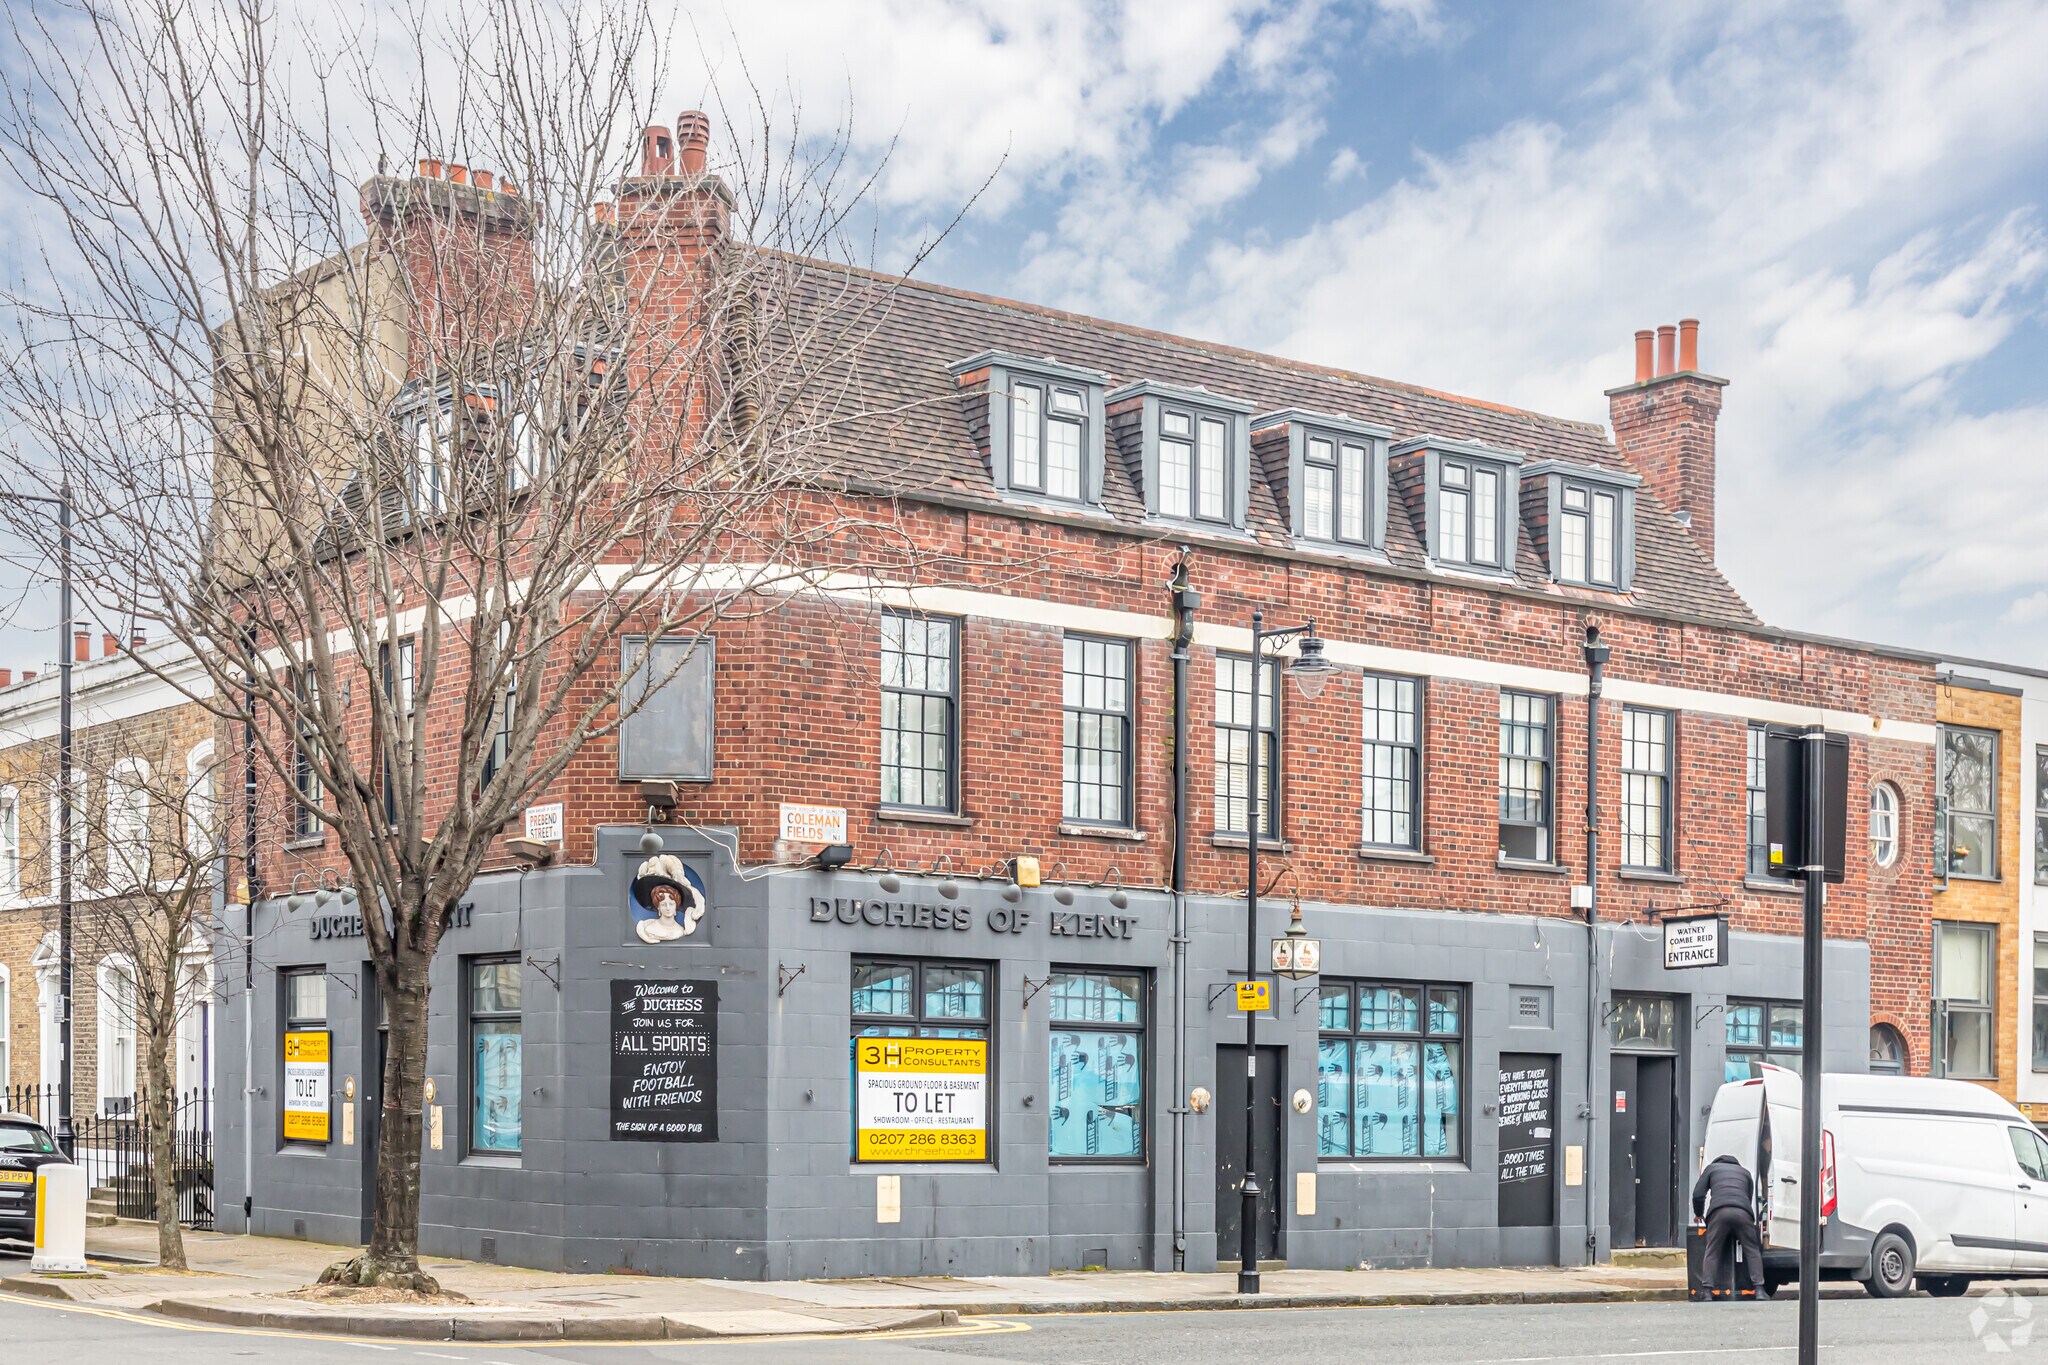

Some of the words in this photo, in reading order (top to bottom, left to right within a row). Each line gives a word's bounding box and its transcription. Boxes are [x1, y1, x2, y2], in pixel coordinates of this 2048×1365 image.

[530, 813, 558, 827] PREBEND
[787, 812, 841, 828] COLEMAN
[530, 826, 553, 839] STREET
[786, 826, 824, 840] FIELDS
[810, 896, 973, 931] DUCHESS
[988, 907, 1032, 935] OF
[1050, 911, 1141, 940] KENT
[309, 914, 364, 940] DUCHE
[1677, 926, 1706, 936] WATNEY
[1670, 936, 1693, 946] COMBE
[1697, 934, 1714, 943] REID
[1668, 948, 1714, 963] ENTRANCE
[634, 984, 679, 997] Welcome
[681, 984, 694, 994] to
[624, 1000, 636, 1010] THE
[644, 998, 702, 1012] DUCHESS
[632, 1018, 654, 1027] JOIN
[657, 1018, 672, 1028] US
[675, 1018, 703, 1028] FOR...
[620, 1036, 648, 1052] ALL
[652, 1036, 707, 1052] SPORTS
[904, 1046, 981, 1056] PROPERTY
[643, 1060, 686, 1076] ENJOY
[904, 1057, 981, 1067] CONSULTANTS
[1512, 1070, 1526, 1080] HAVE
[1526, 1069, 1546, 1080] TAKEN
[295, 1080, 304, 1097] TO
[306, 1080, 317, 1098] LET
[632, 1076, 695, 1092] FOOTBALL
[868, 1079, 896, 1090] SPACIOUS
[898, 1080, 924, 1090] GROUND
[924, 1080, 942, 1090] FLOOR
[944, 1081, 948, 1090] &
[949, 1081, 980, 1090] BASEMENT
[1500, 1080, 1532, 1094] EVERYTHING
[1534, 1079, 1549, 1090] FROM
[622, 1094, 651, 1109] WITH
[654, 1090, 702, 1106] FRIENDS
[893, 1092, 918, 1113] TO
[925, 1092, 956, 1114] LET
[1506, 1091, 1530, 1103] WORKING
[1531, 1089, 1548, 1100] CLASS
[1503, 1102, 1527, 1115] EXCEPT
[1528, 1101, 1540, 1111] OUR
[874, 1116, 910, 1124] SHOWROOM
[914, 1116, 934, 1124] OFFICE
[938, 1116, 974, 1125] RESTAURANT
[1522, 1110, 1548, 1123] HUMOUR
[616, 1122, 630, 1131] THE
[630, 1122, 646, 1132] SIGN
[648, 1123, 658, 1131] OF
[666, 1124, 686, 1132] GOOD
[688, 1124, 702, 1133] PUB
[870, 1134, 905, 1145] 0207
[910, 1134, 936, 1145] 286
[940, 1134, 977, 1145] 8363
[870, 1147, 976, 1156] www.threeh.co.uk
[1524, 1150, 1544, 1162] TIMES
[12, 1172, 29, 1180] PPV
[1500, 1168, 1514, 1180] ALL
[1515, 1166, 1528, 1177] THE
[1529, 1163, 1546, 1175] TIME
